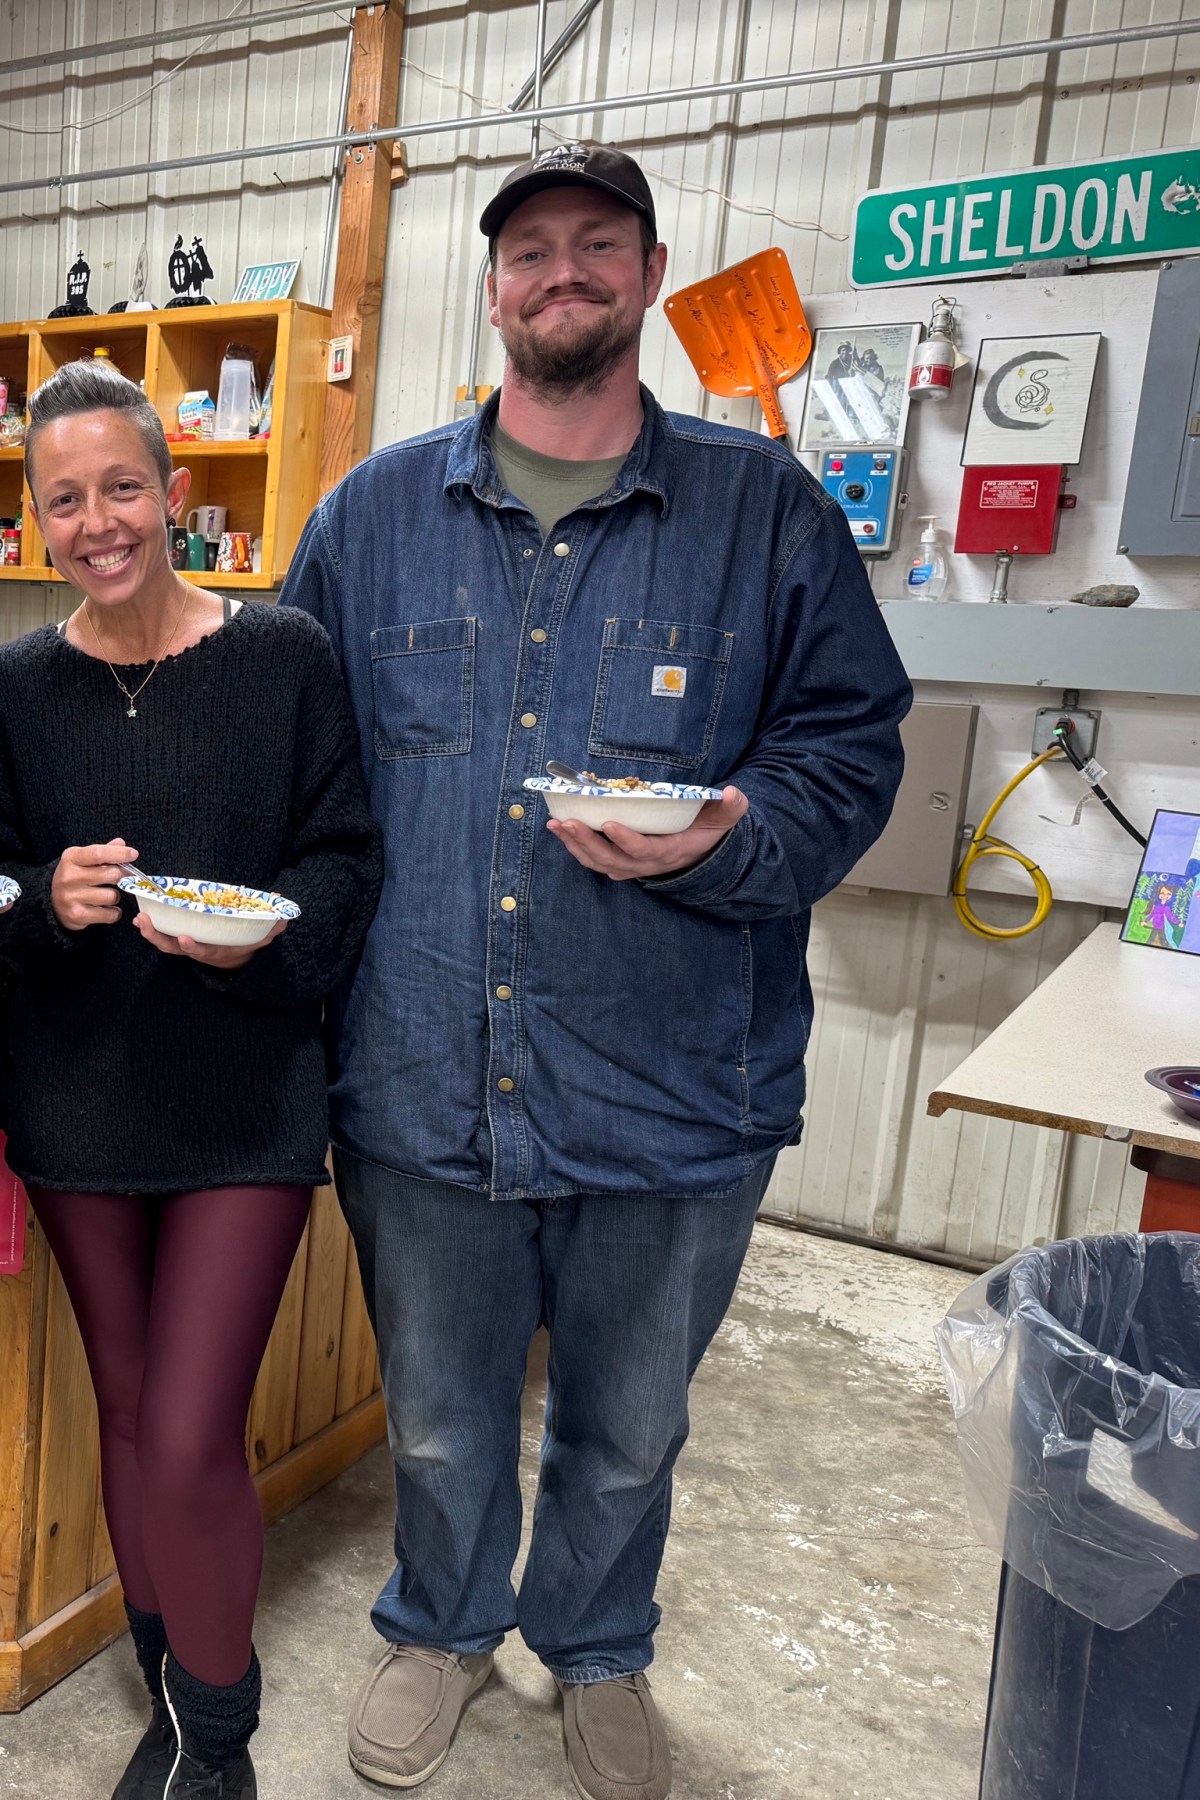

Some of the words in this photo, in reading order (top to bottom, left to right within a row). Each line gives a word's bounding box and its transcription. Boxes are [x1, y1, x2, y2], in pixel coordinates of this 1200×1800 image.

[884, 170, 1152, 271] SHELDON
[69, 272, 87, 285] R.I.P.
[237, 263, 297, 302] HAPPY
